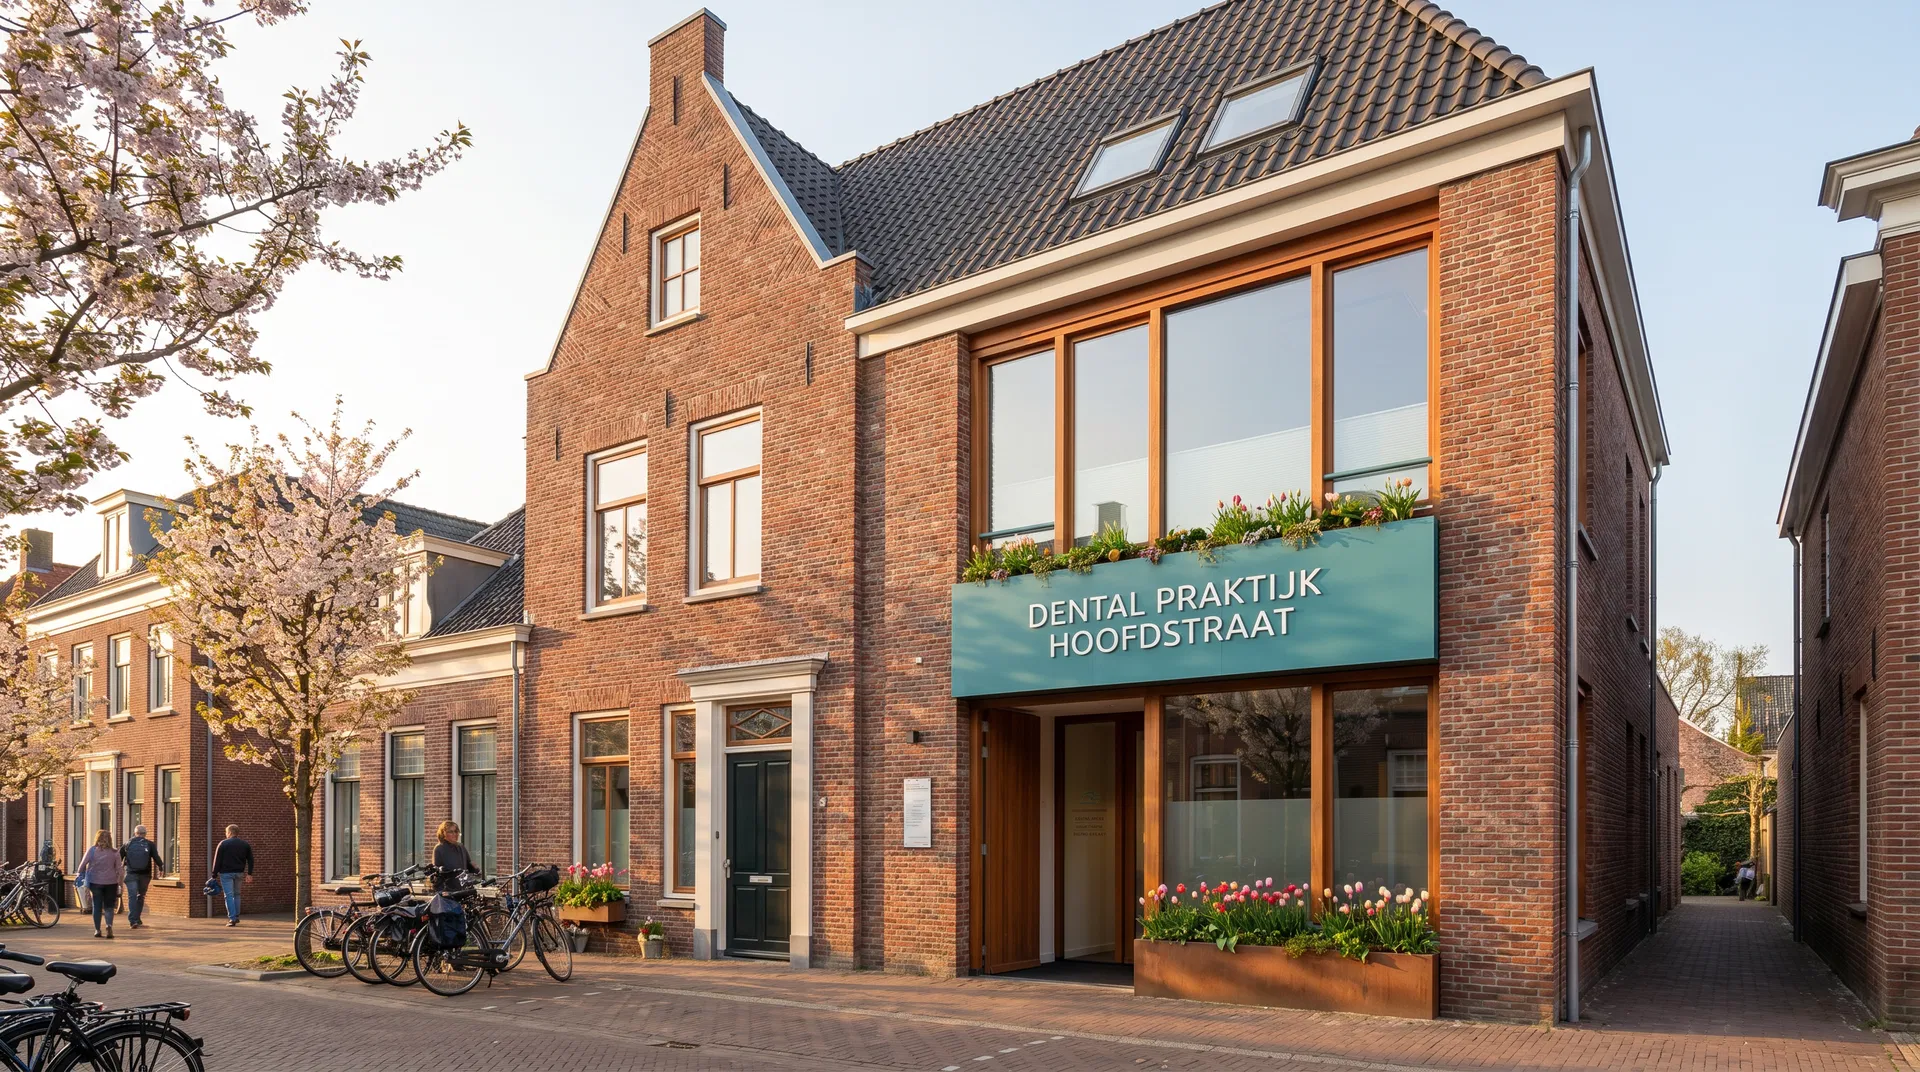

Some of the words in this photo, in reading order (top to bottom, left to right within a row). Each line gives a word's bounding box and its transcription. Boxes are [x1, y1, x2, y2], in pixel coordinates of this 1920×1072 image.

[1028, 590, 1147, 629] DENTAL
[1157, 567, 1323, 614] PRAKTIJK
[1050, 606, 1296, 658] HOOFDSTRAAT
